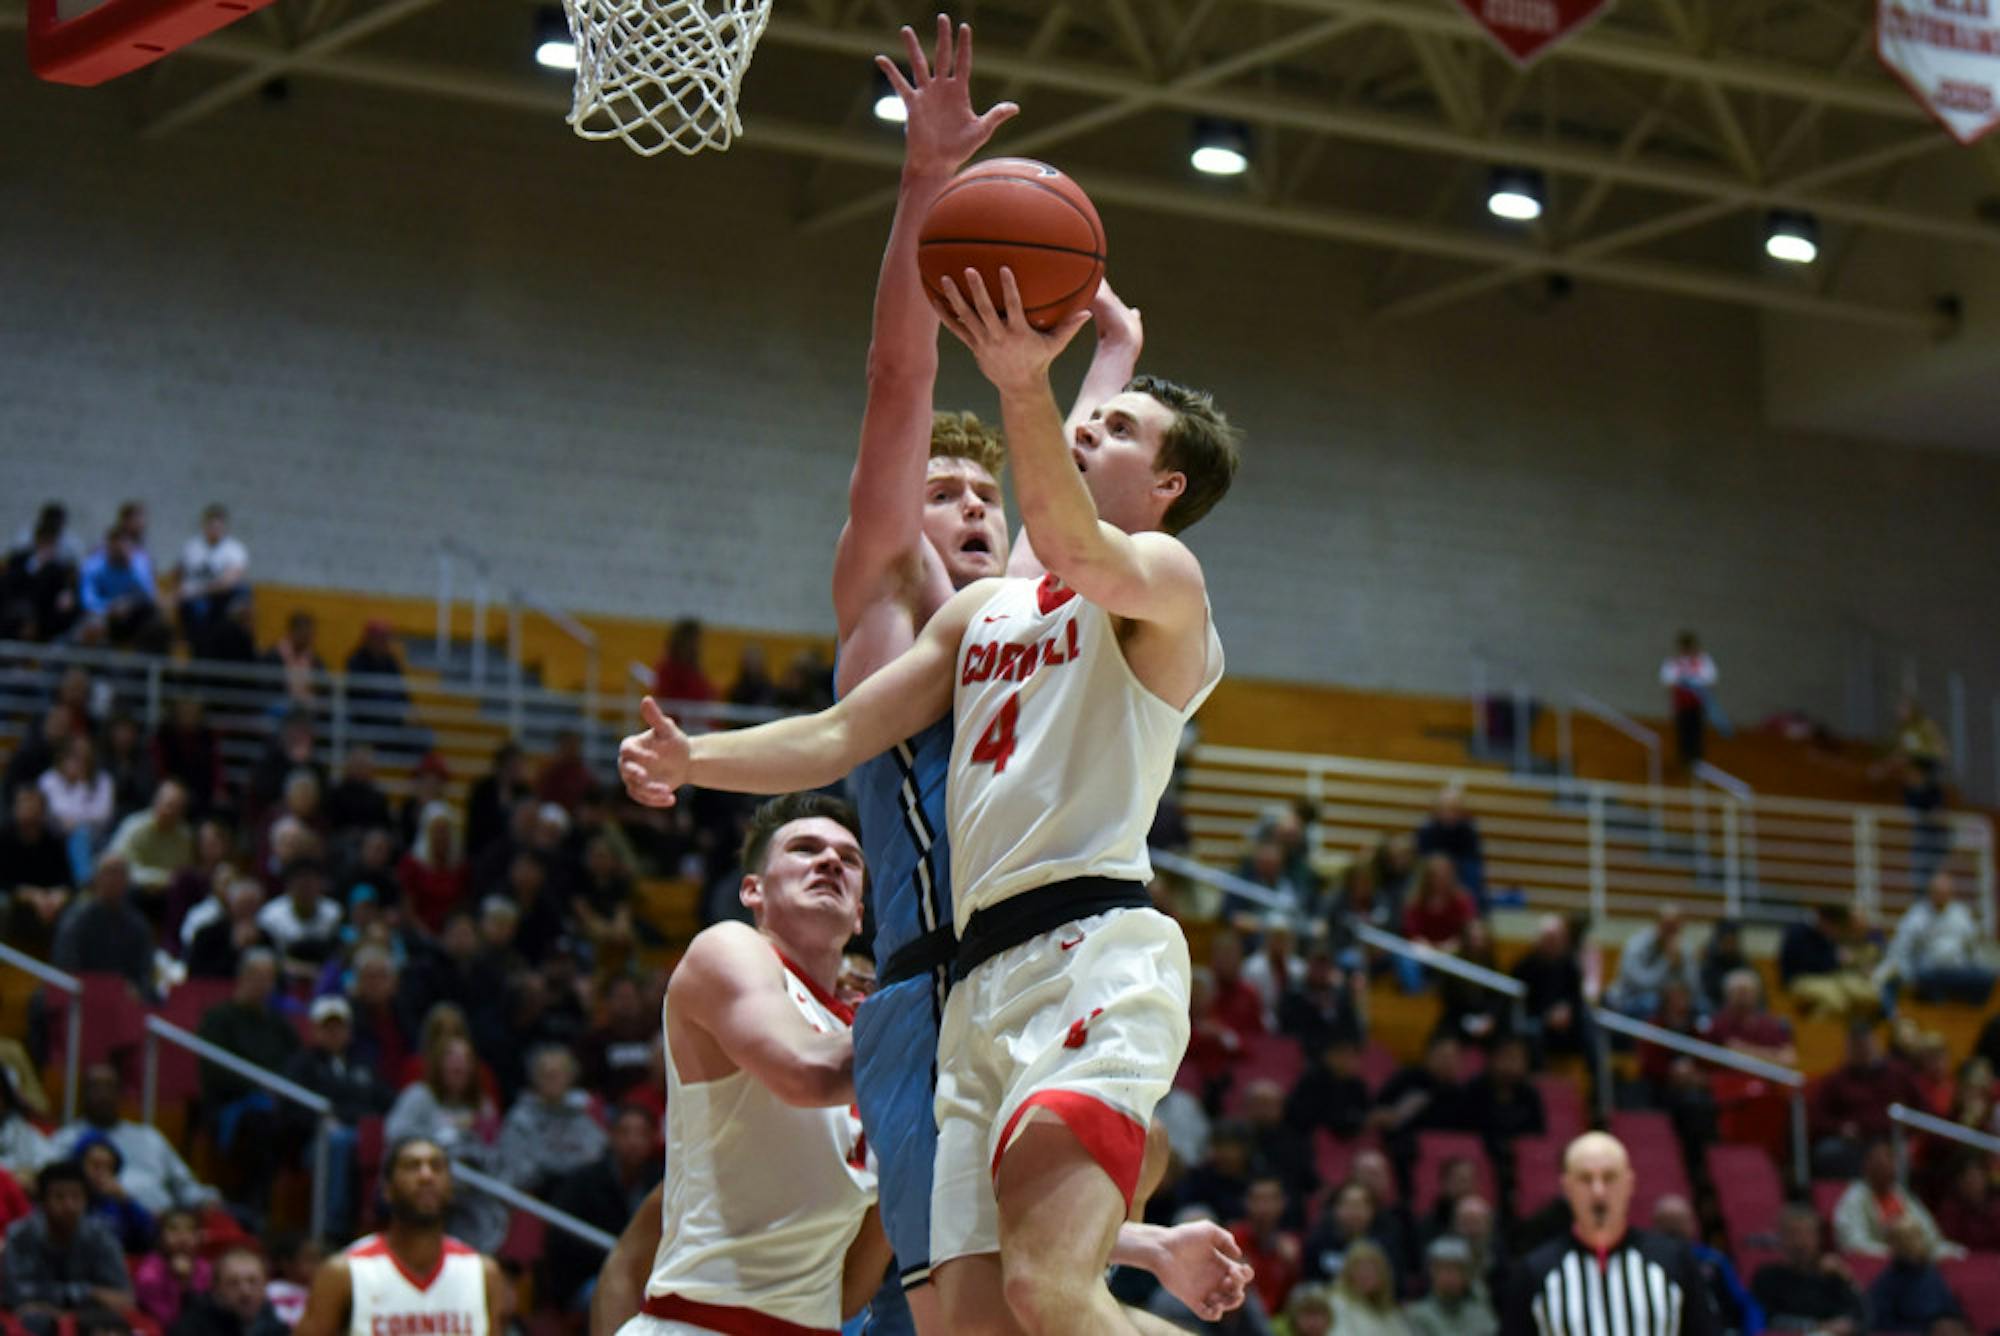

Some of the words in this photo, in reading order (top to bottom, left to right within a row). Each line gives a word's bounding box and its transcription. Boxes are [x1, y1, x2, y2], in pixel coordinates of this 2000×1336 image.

[961, 617, 1081, 686] CORNLL
[970, 690, 1021, 776] 4
[371, 1311, 473, 1336] CORNELL
